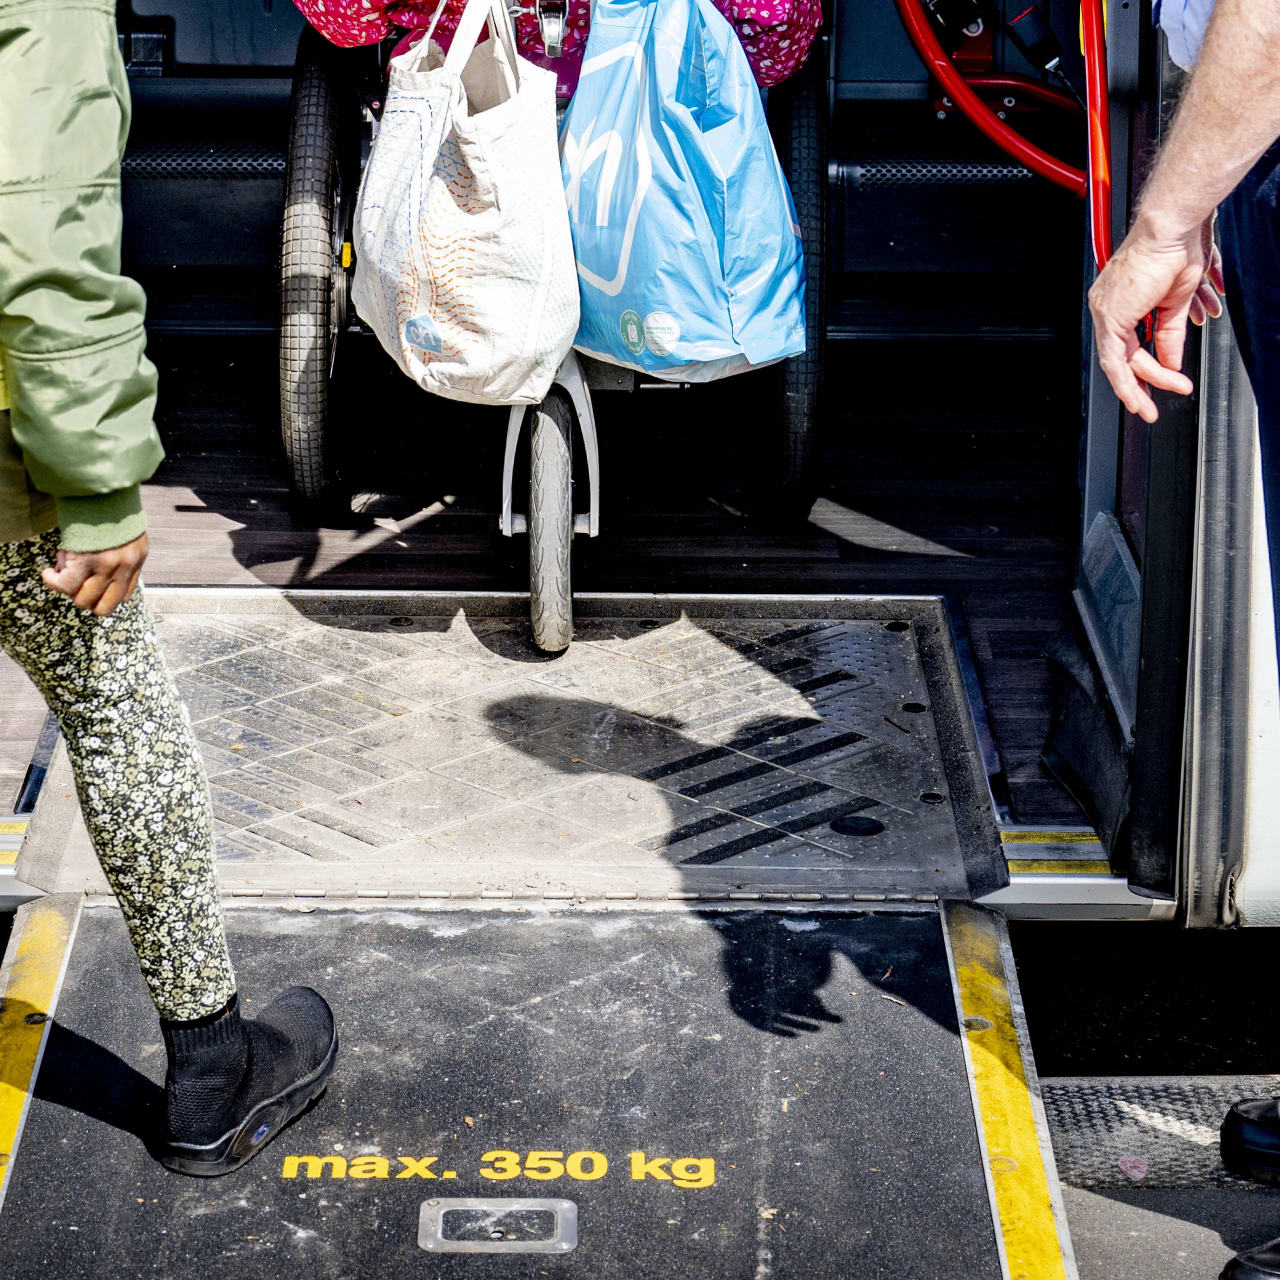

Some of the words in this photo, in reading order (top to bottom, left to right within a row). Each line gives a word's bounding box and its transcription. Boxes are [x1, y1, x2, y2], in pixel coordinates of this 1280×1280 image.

[282, 1154, 458, 1180] max.
[479, 1150, 609, 1181] 350
[630, 1151, 716, 1189] kg
